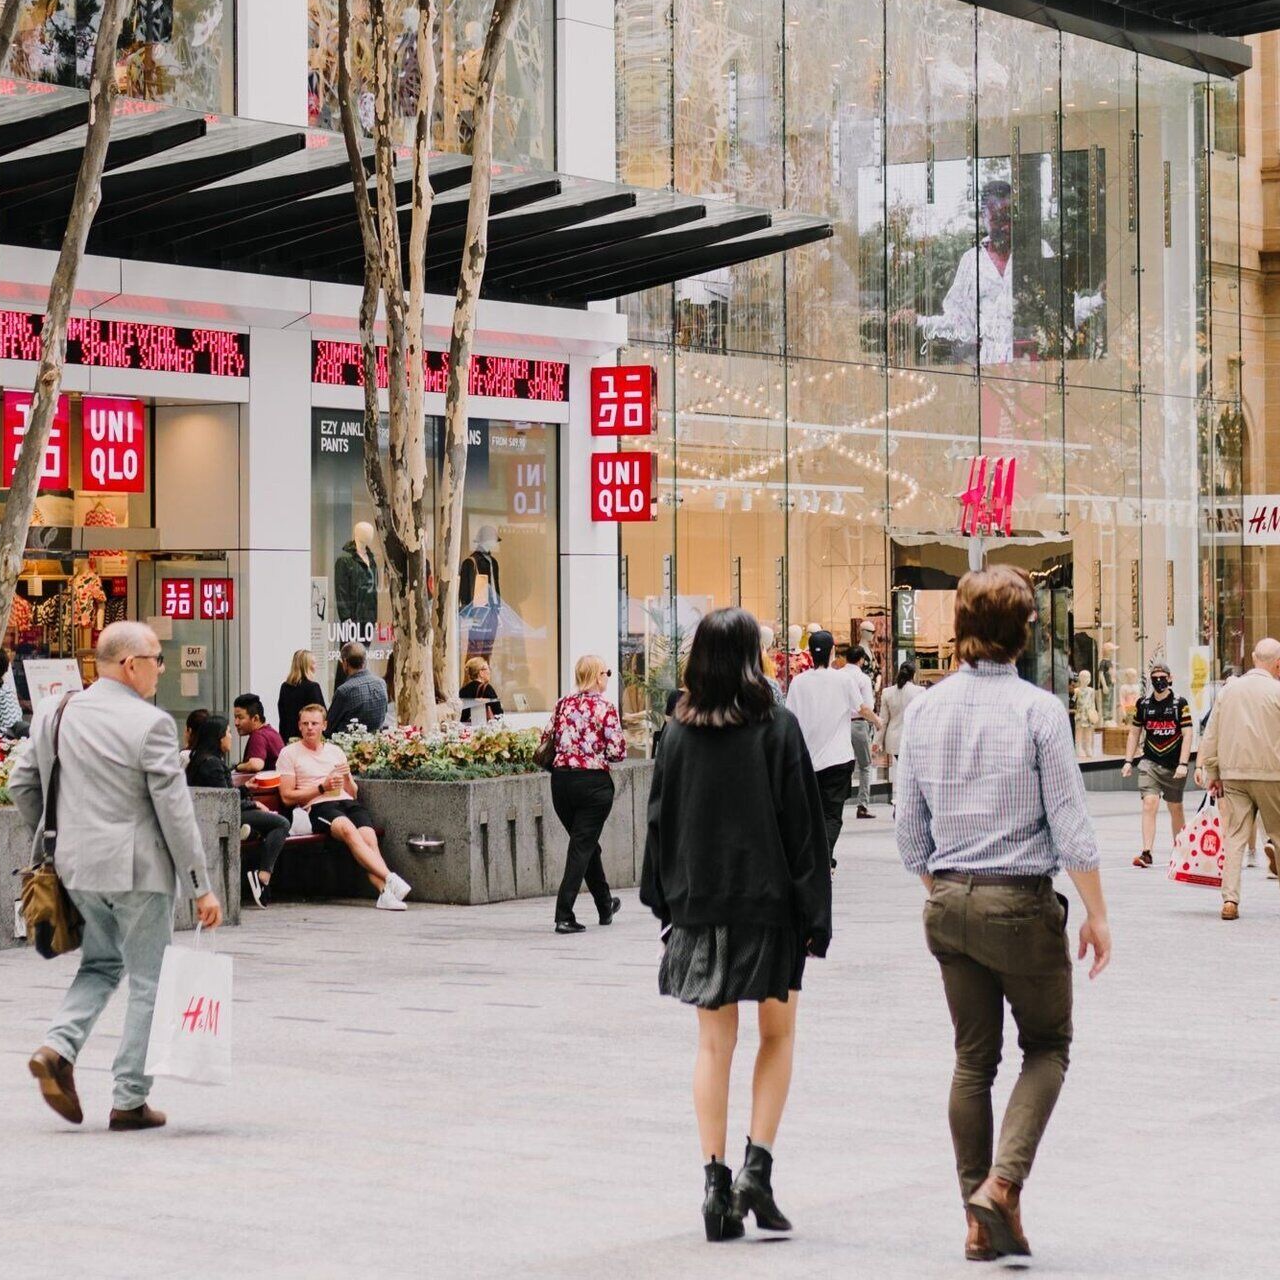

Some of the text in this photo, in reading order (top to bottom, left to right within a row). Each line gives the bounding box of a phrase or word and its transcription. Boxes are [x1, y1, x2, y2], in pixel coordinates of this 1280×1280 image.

[90, 409, 134, 443] UNI
[320, 420, 365, 437] EZY ANKL
[320, 437, 349, 453] PANTS
[90, 447, 138, 485] QLO
[598, 460, 640, 485] UNI
[598, 488, 644, 517] QLO
[187, 647, 201, 655] EXIT
[185, 659, 203, 668] ONLY
[1153, 728, 1176, 736] PLUS
[181, 995, 220, 1036] H&M
